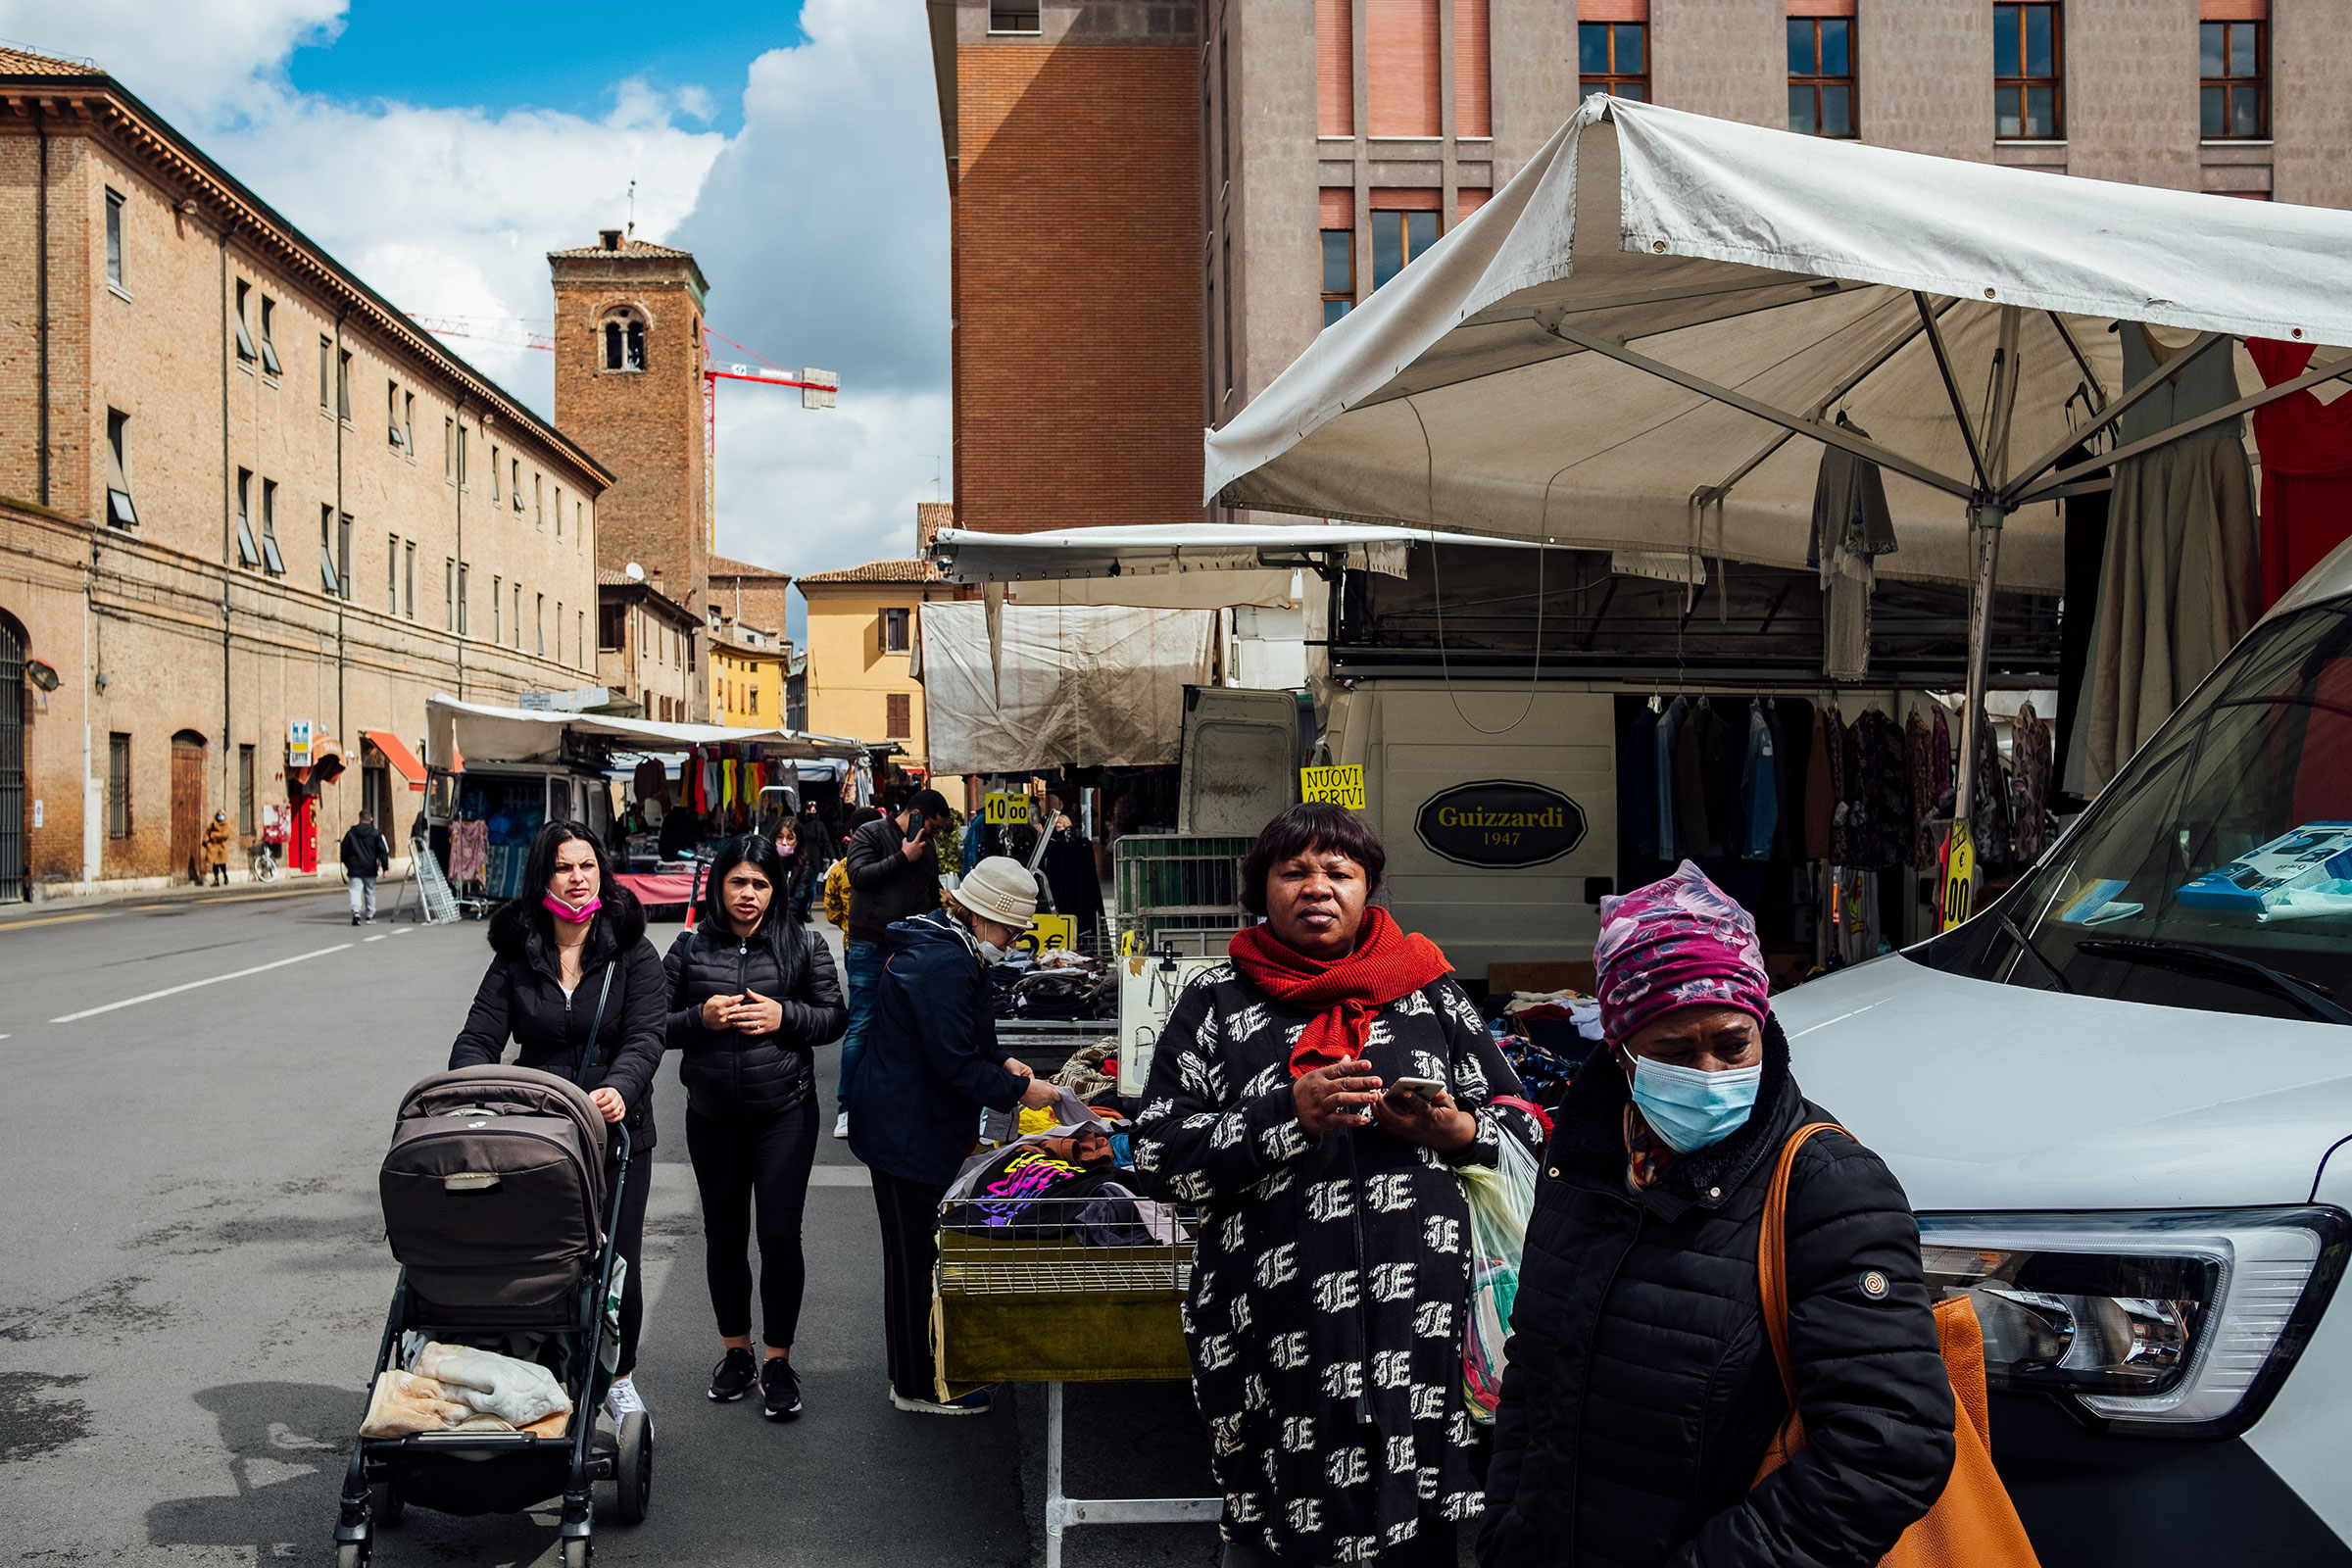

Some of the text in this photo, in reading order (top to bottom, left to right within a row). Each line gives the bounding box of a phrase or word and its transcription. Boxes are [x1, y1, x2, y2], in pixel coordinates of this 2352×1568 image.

[1306, 767, 1358, 788] NUOVI
[1307, 787, 1363, 806] ARRIVI
[988, 798, 1005, 819] 10
[1009, 807, 1027, 819] 00
[1438, 807, 1564, 827] Guizzardi
[1484, 832, 1520, 846] 1947
